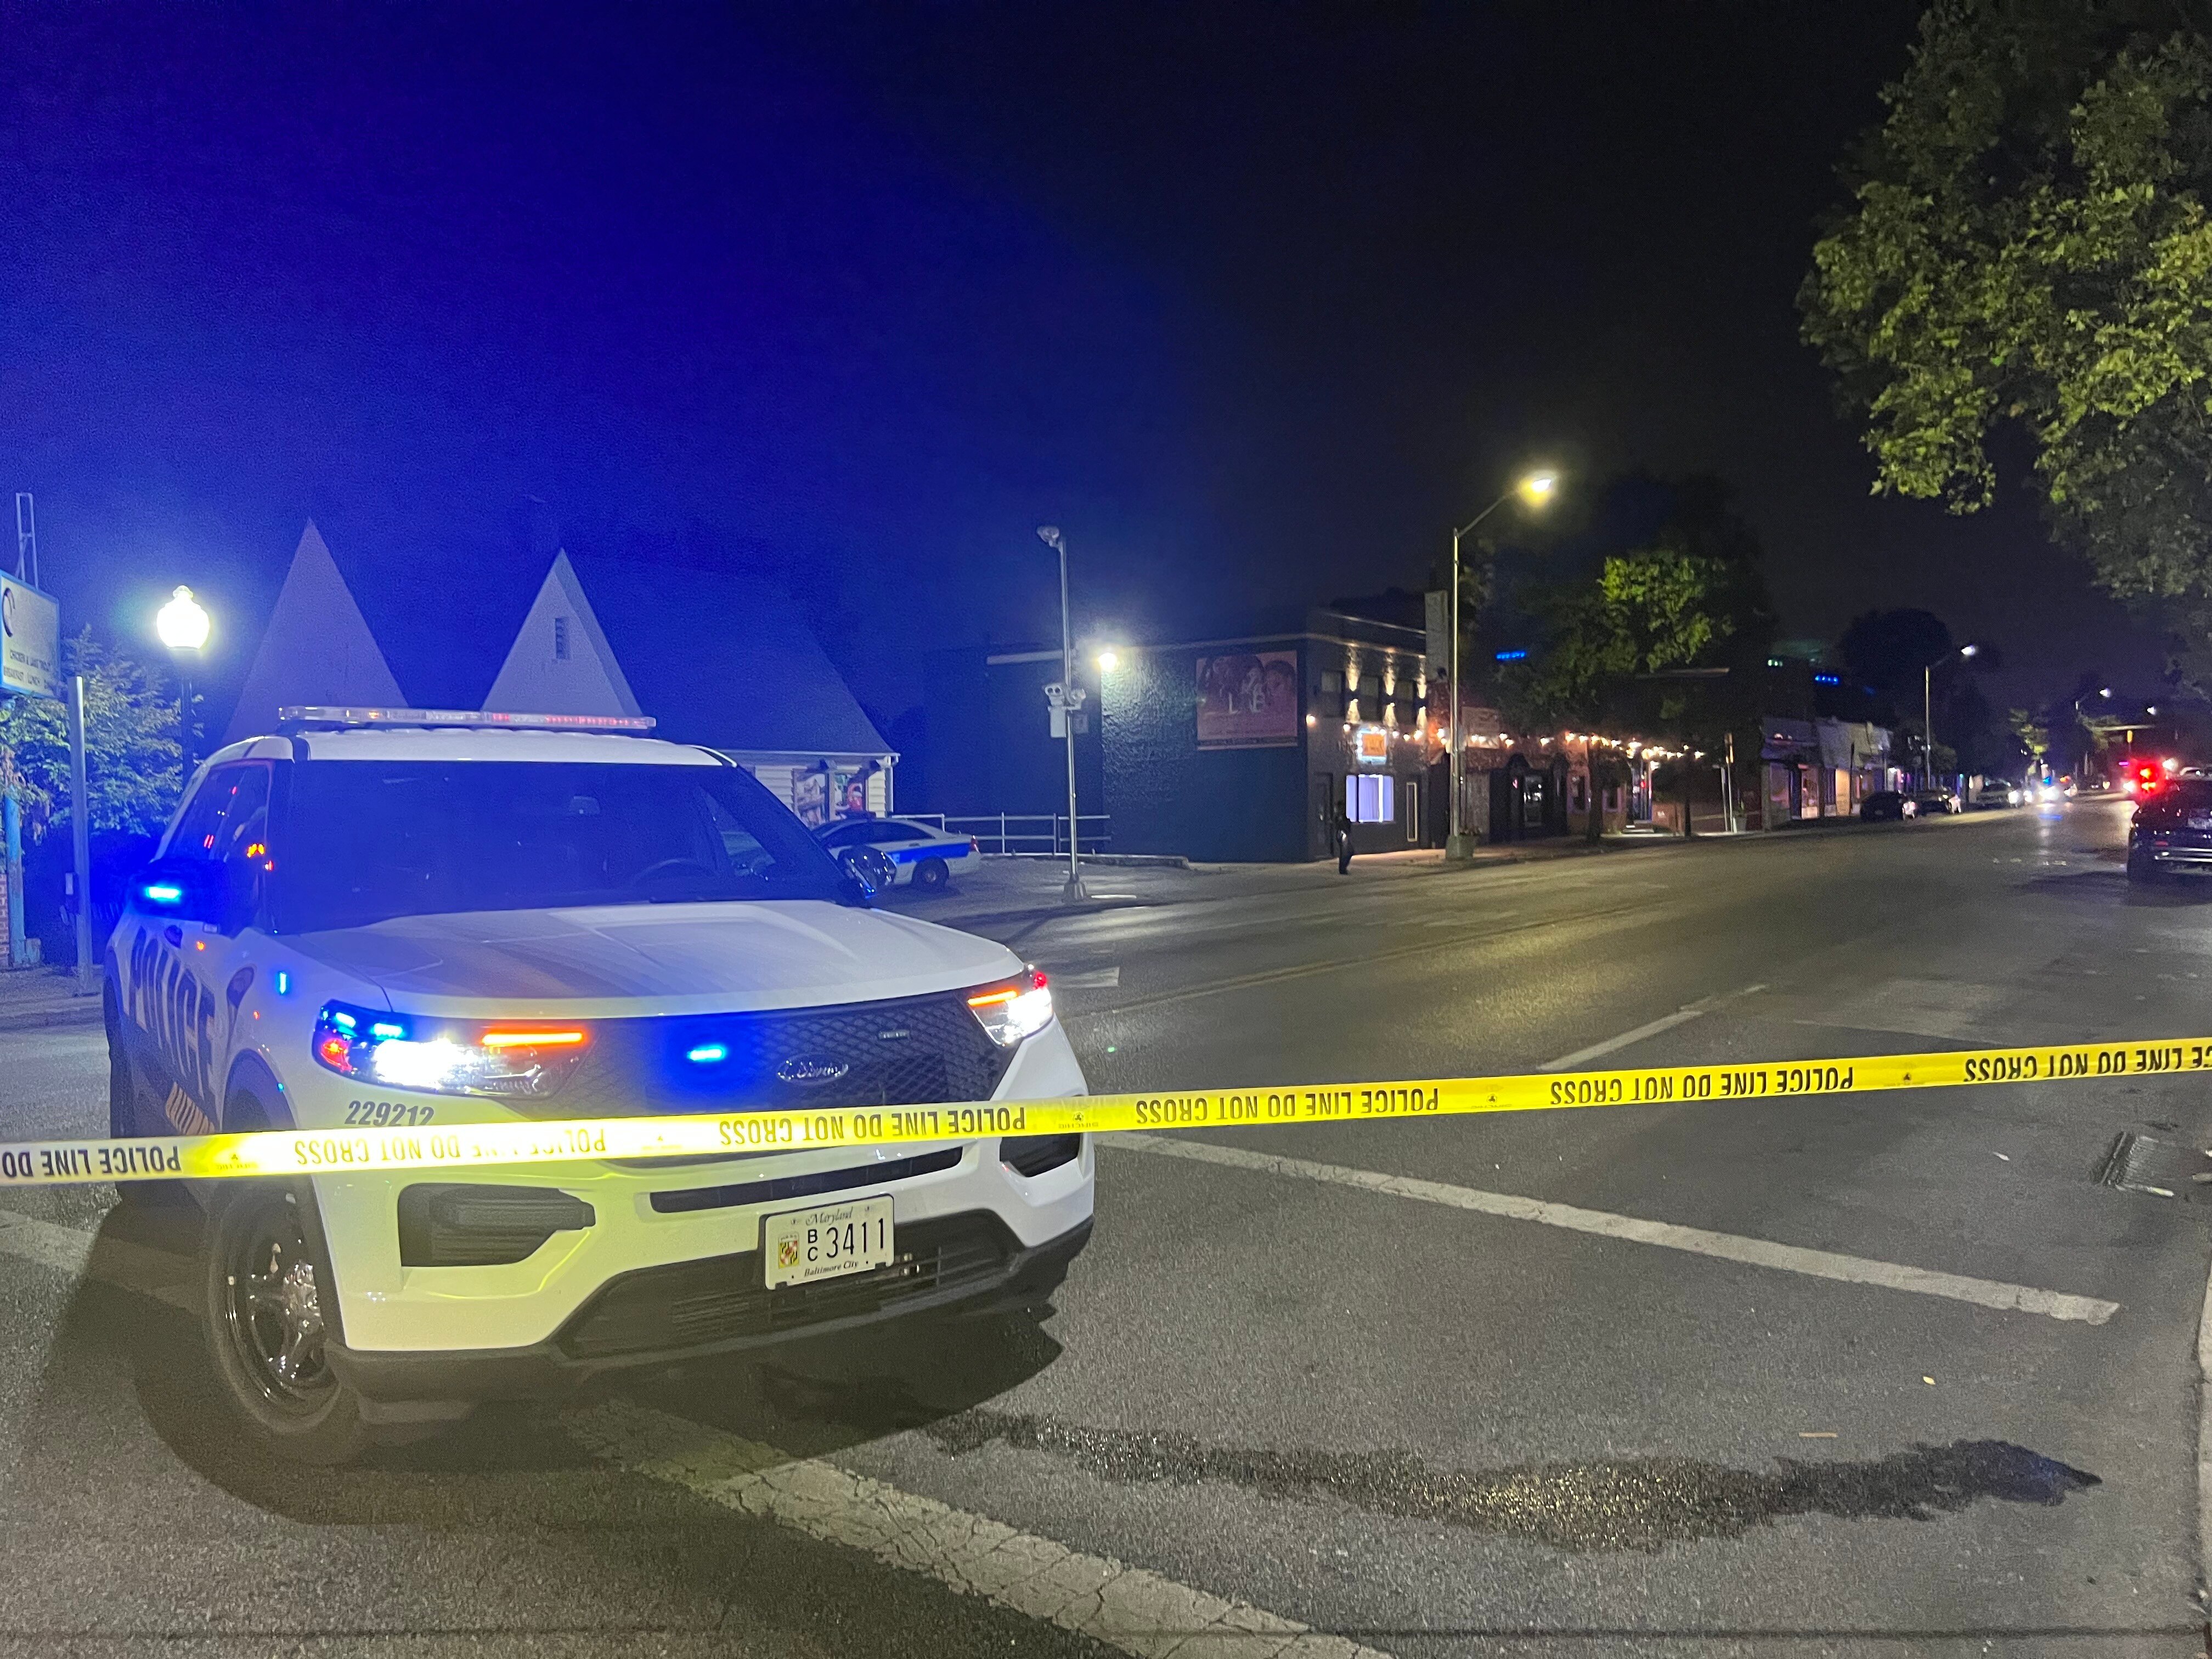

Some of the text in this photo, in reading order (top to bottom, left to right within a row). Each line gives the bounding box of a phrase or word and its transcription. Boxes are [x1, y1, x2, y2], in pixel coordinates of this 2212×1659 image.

[1963, 1056, 2037, 1082] CROSS
[2043, 1053, 2088, 1078] NOT
[2097, 1051, 2126, 1074] DO
[2134, 1047, 2182, 1072] LINE
[1550, 1066, 1853, 1105] POLICE LINE DO NOT CROSS
[345, 1100, 435, 1126] 229212
[1136, 1088, 1438, 1124] POLICE LINE DO NOT CROSS
[720, 1107, 1025, 1145] POLICE LINE DO NOT CROSS
[295, 1138, 370, 1164] CROSS
[382, 1136, 422, 1160] NOT
[431, 1135, 461, 1158] DO
[2, 1146, 182, 1178] POLICE LINE DO
[805, 1206, 854, 1227] Maryland
[808, 1228, 818, 1244] B
[826, 1218, 884, 1259] 3411
[808, 1246, 819, 1261] C
[804, 1260, 860, 1277] Baltimore City
